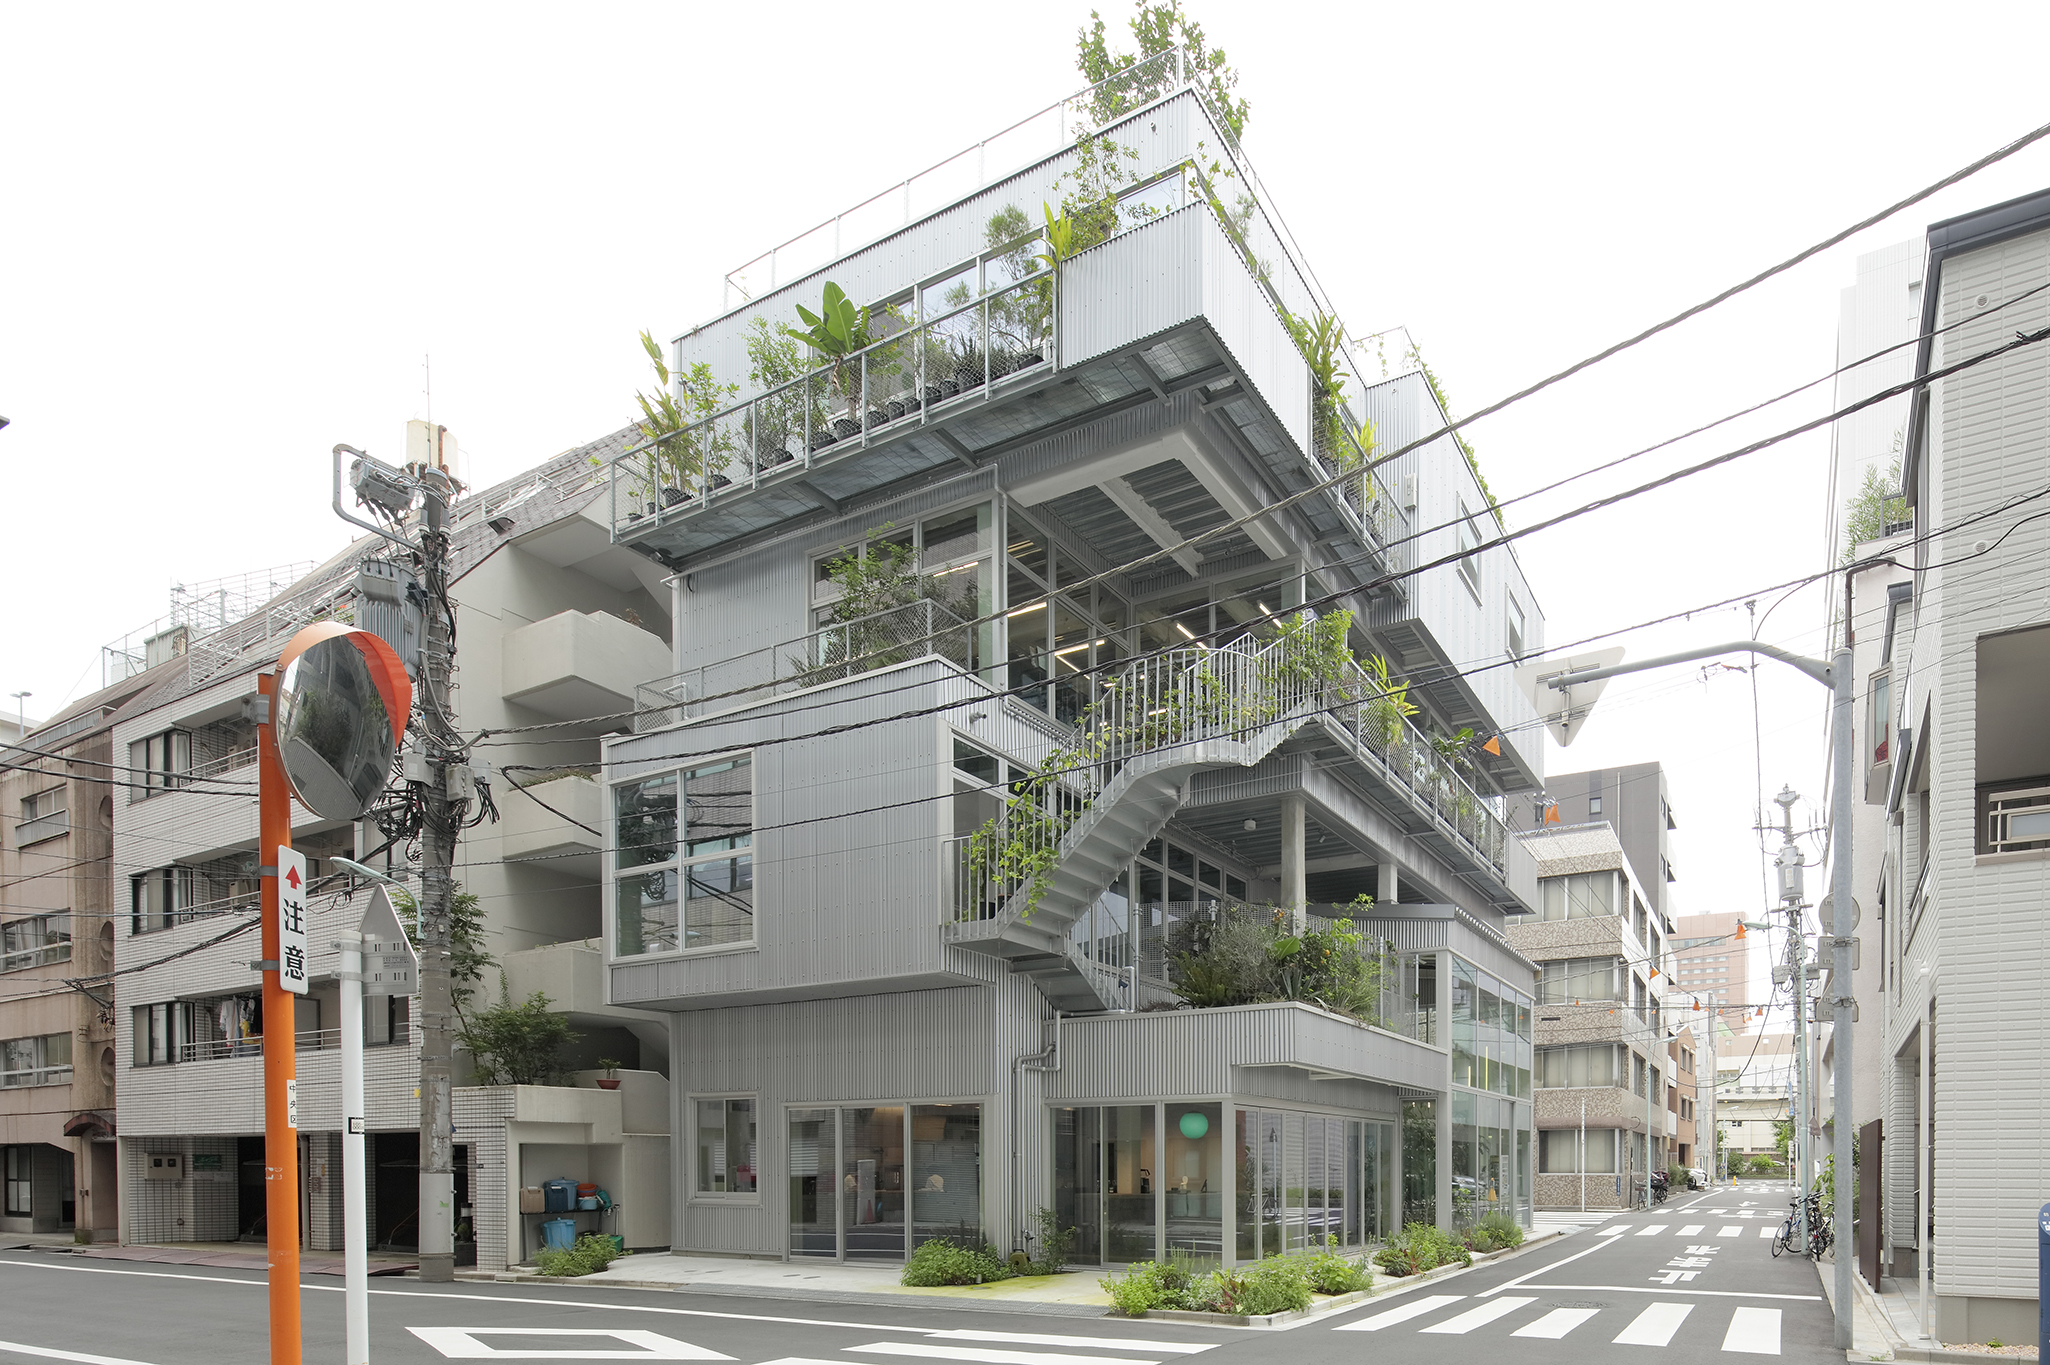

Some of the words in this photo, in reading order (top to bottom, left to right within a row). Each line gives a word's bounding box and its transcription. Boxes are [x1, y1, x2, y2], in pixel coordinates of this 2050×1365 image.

[283, 898, 305, 981] 注意
[1648, 1245, 1721, 1284] 止まれ
